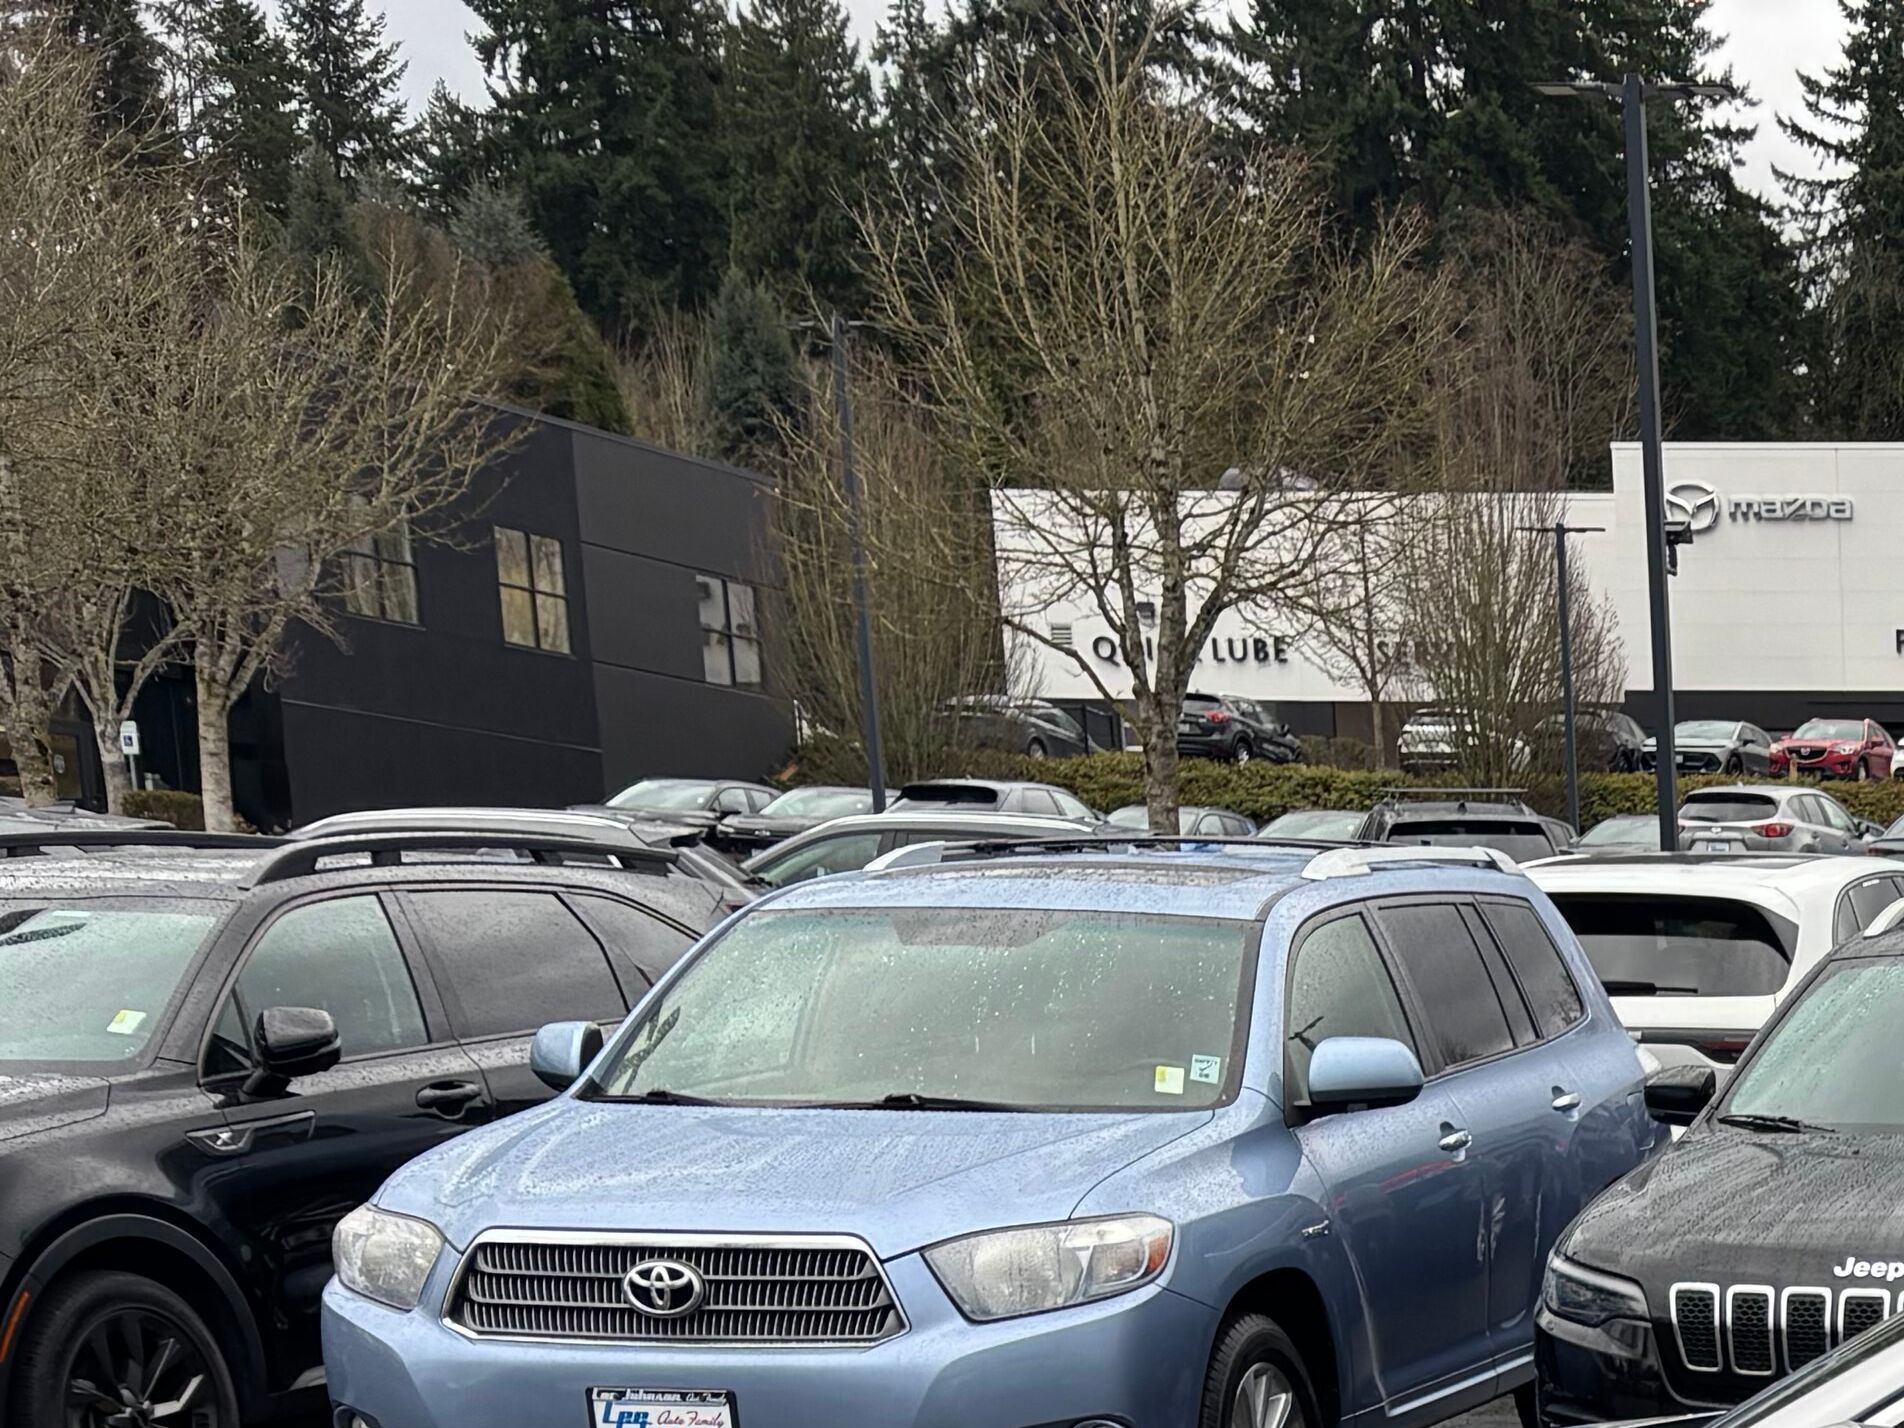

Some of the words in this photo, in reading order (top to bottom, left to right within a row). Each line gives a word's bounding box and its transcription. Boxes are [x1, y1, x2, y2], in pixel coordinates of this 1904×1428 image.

[1212, 637, 1288, 663] LUBE
[602, 1400, 652, 1424] Lee
[657, 1410, 685, 1426] Auto
